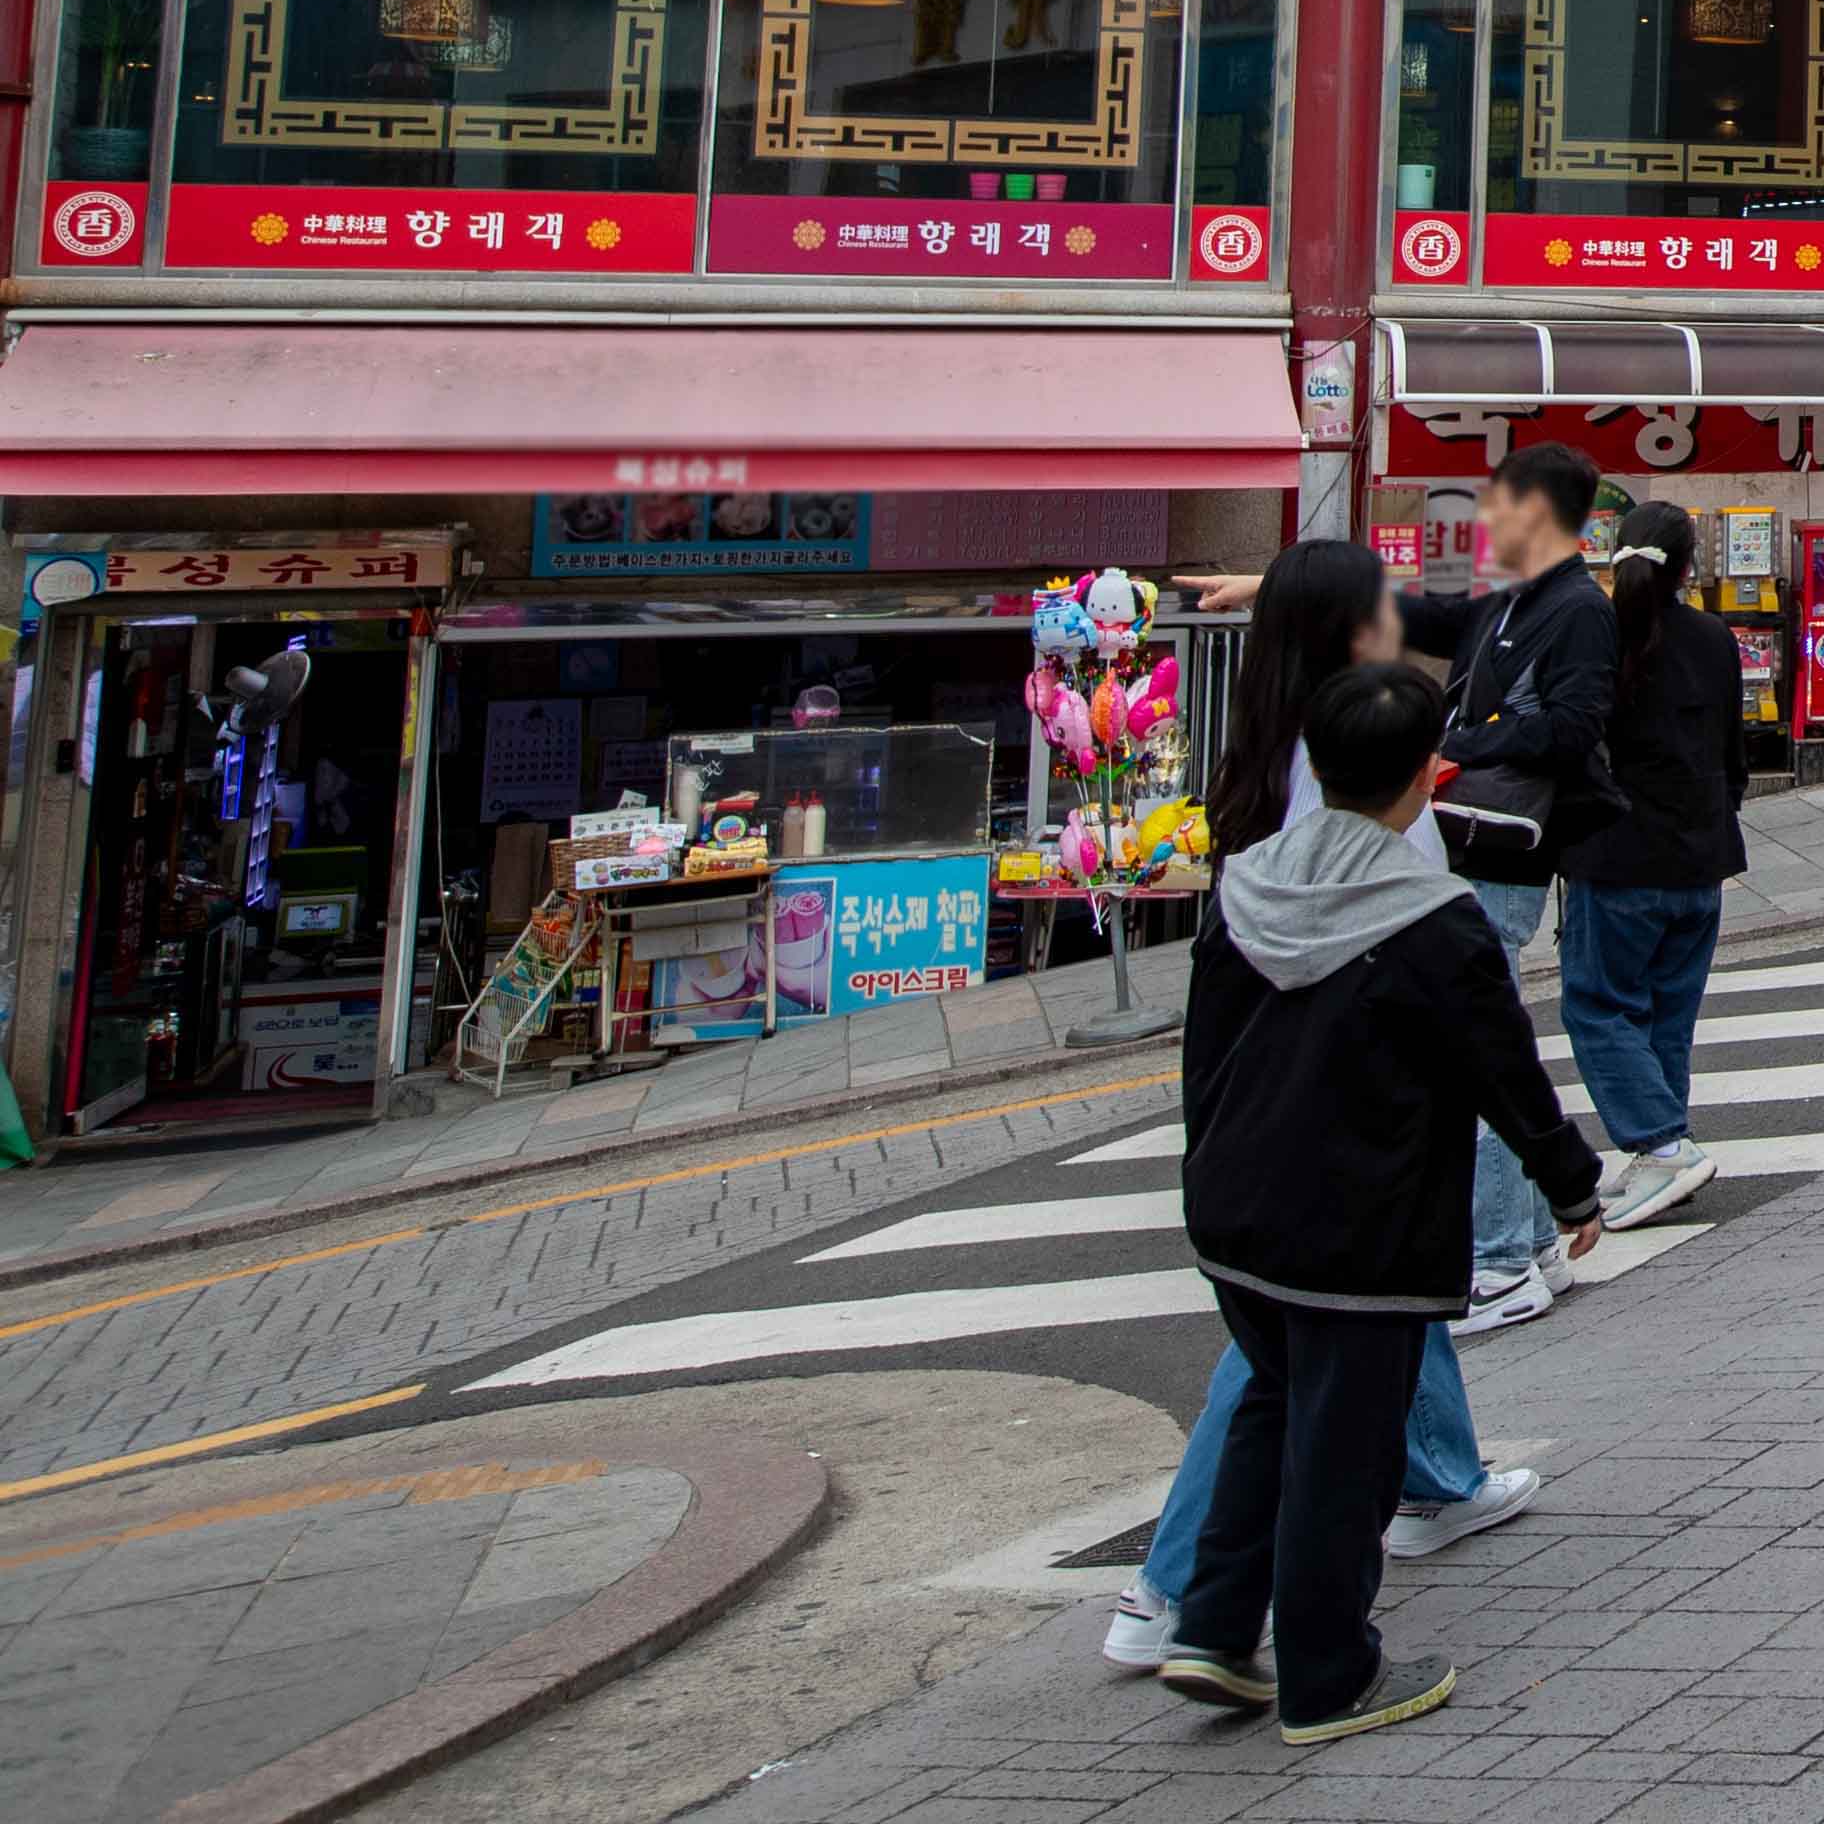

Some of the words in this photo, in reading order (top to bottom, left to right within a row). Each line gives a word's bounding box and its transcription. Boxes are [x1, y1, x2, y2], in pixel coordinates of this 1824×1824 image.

[78, 209, 113, 238] 香
[303, 213, 388, 234] 中華料理
[838, 223, 910, 243] 中華料理
[301, 235, 338, 245] Chinese
[340, 236, 388, 246] Restaurant
[1217, 230, 1247, 257] 香
[1417, 235, 1445, 261] 香
[1582, 240, 1646, 258] 中華料理
[1307, 384, 1350, 399] Lotto
[839, 892, 929, 958] 즉석수제
[936, 888, 981, 953] 철판
[850, 965, 970, 999] 아이스크림
